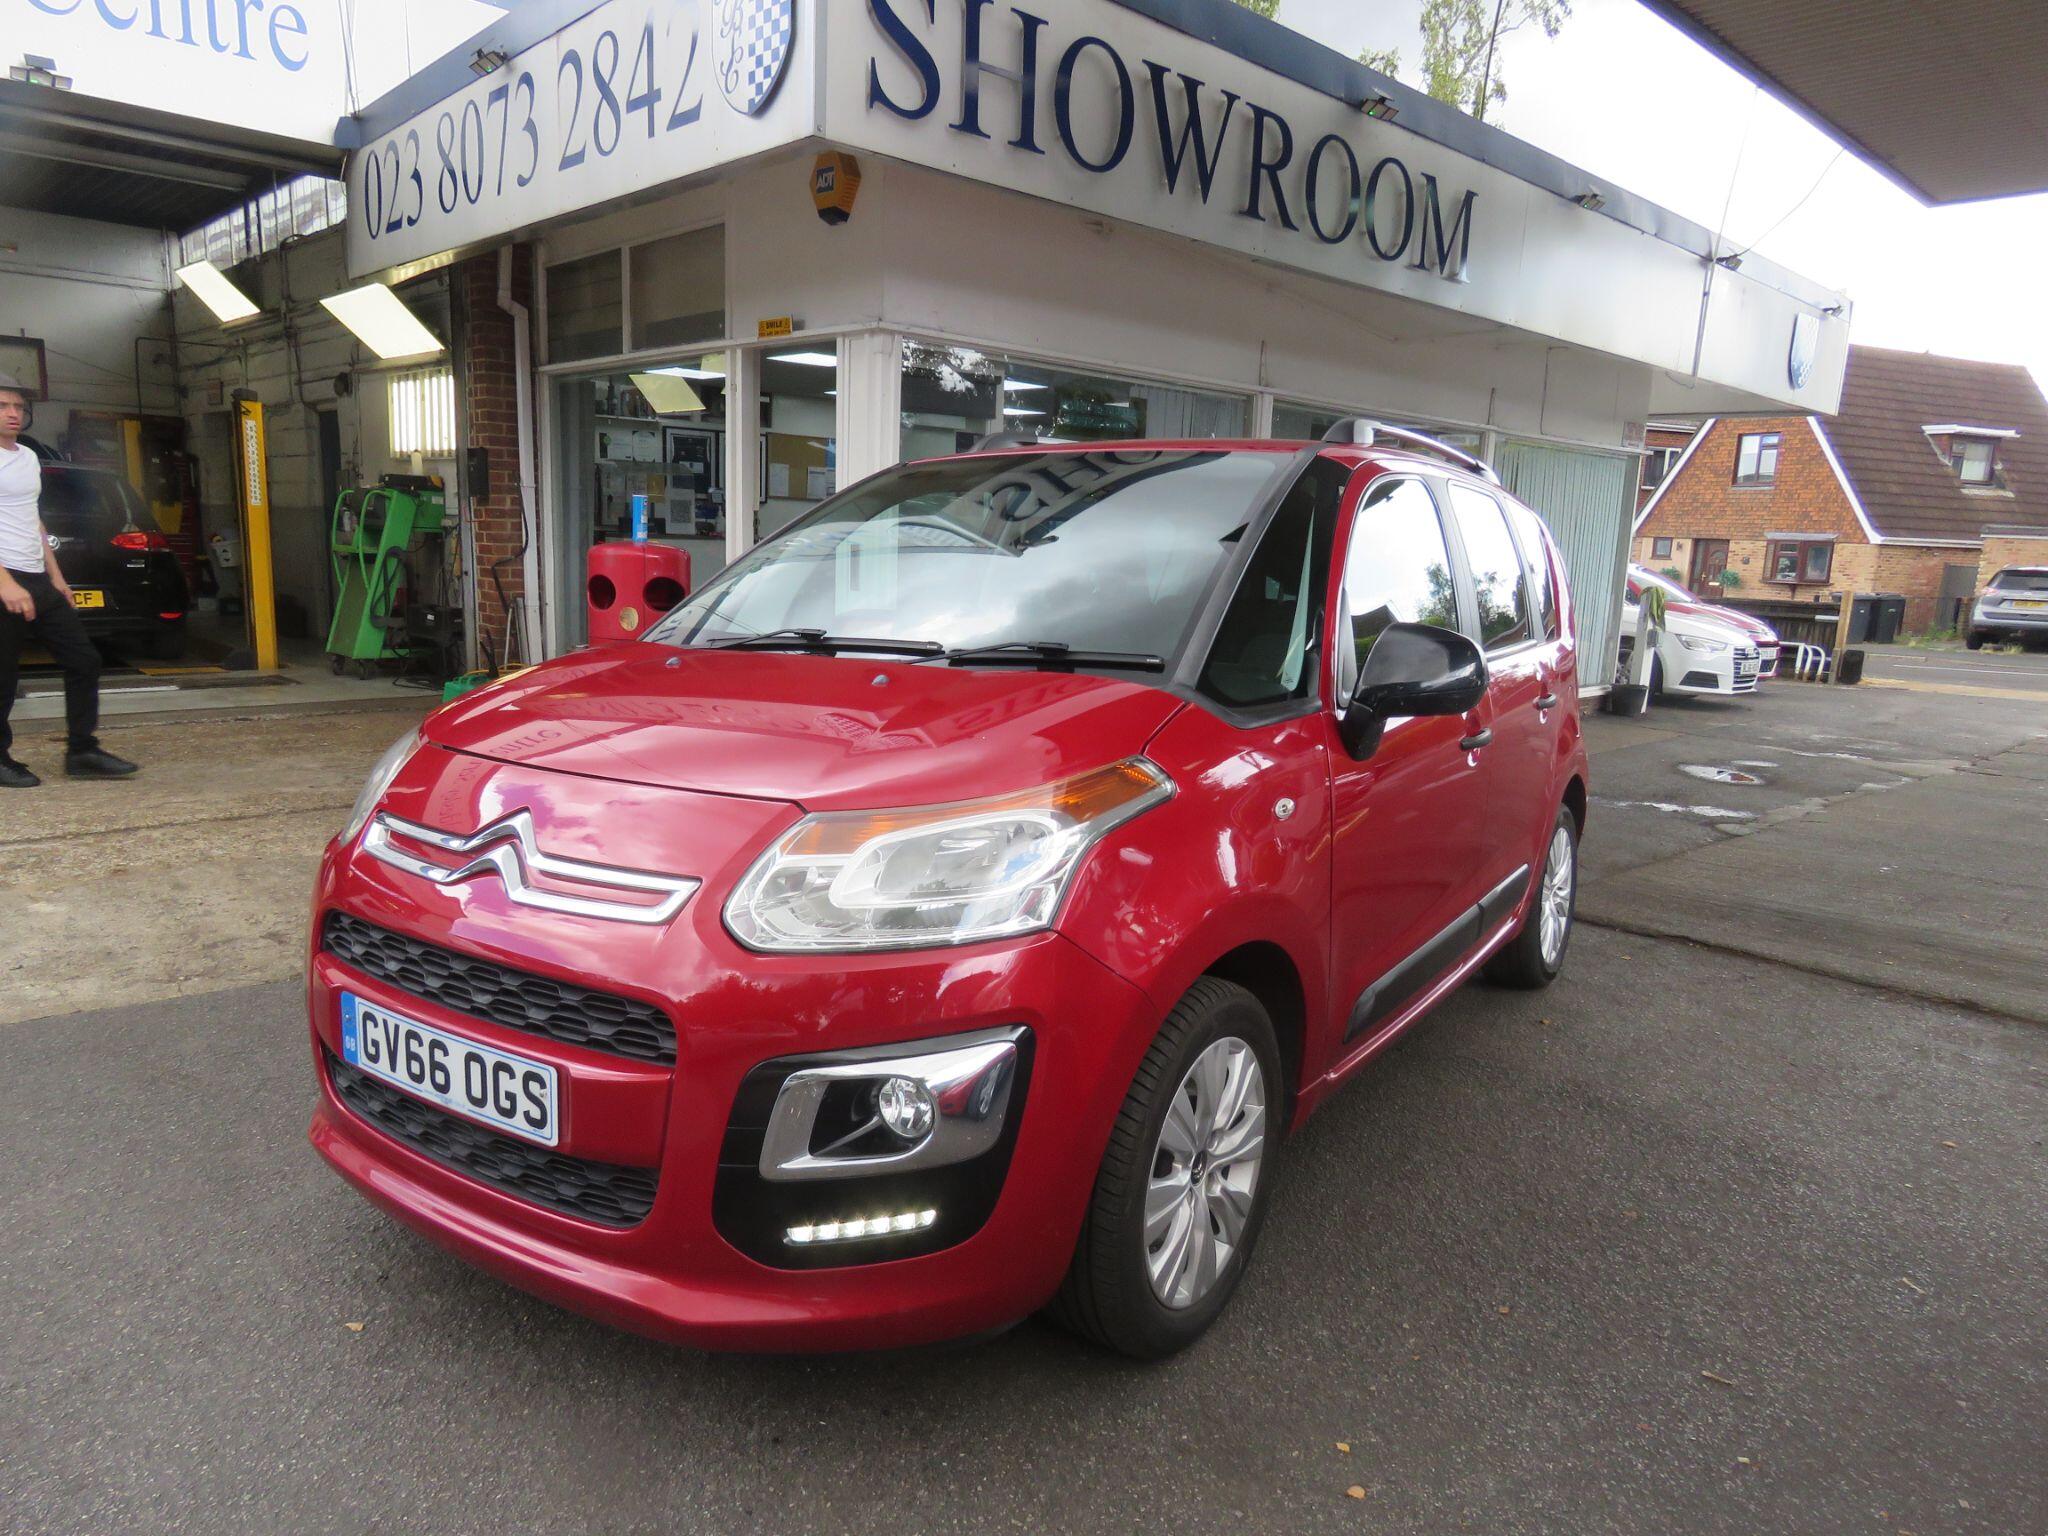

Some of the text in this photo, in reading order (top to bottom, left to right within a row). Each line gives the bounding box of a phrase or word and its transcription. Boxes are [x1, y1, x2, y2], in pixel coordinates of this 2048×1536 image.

[27, 0, 309, 72] ntre
[365, 150, 423, 240] 023
[437, 72, 538, 214] 8073
[557, 5, 703, 172] 2842
[816, 172, 833, 189] ADT
[867, 0, 1479, 284] SHOWROOM
[361, 1010, 548, 1130] GV66 OGS
